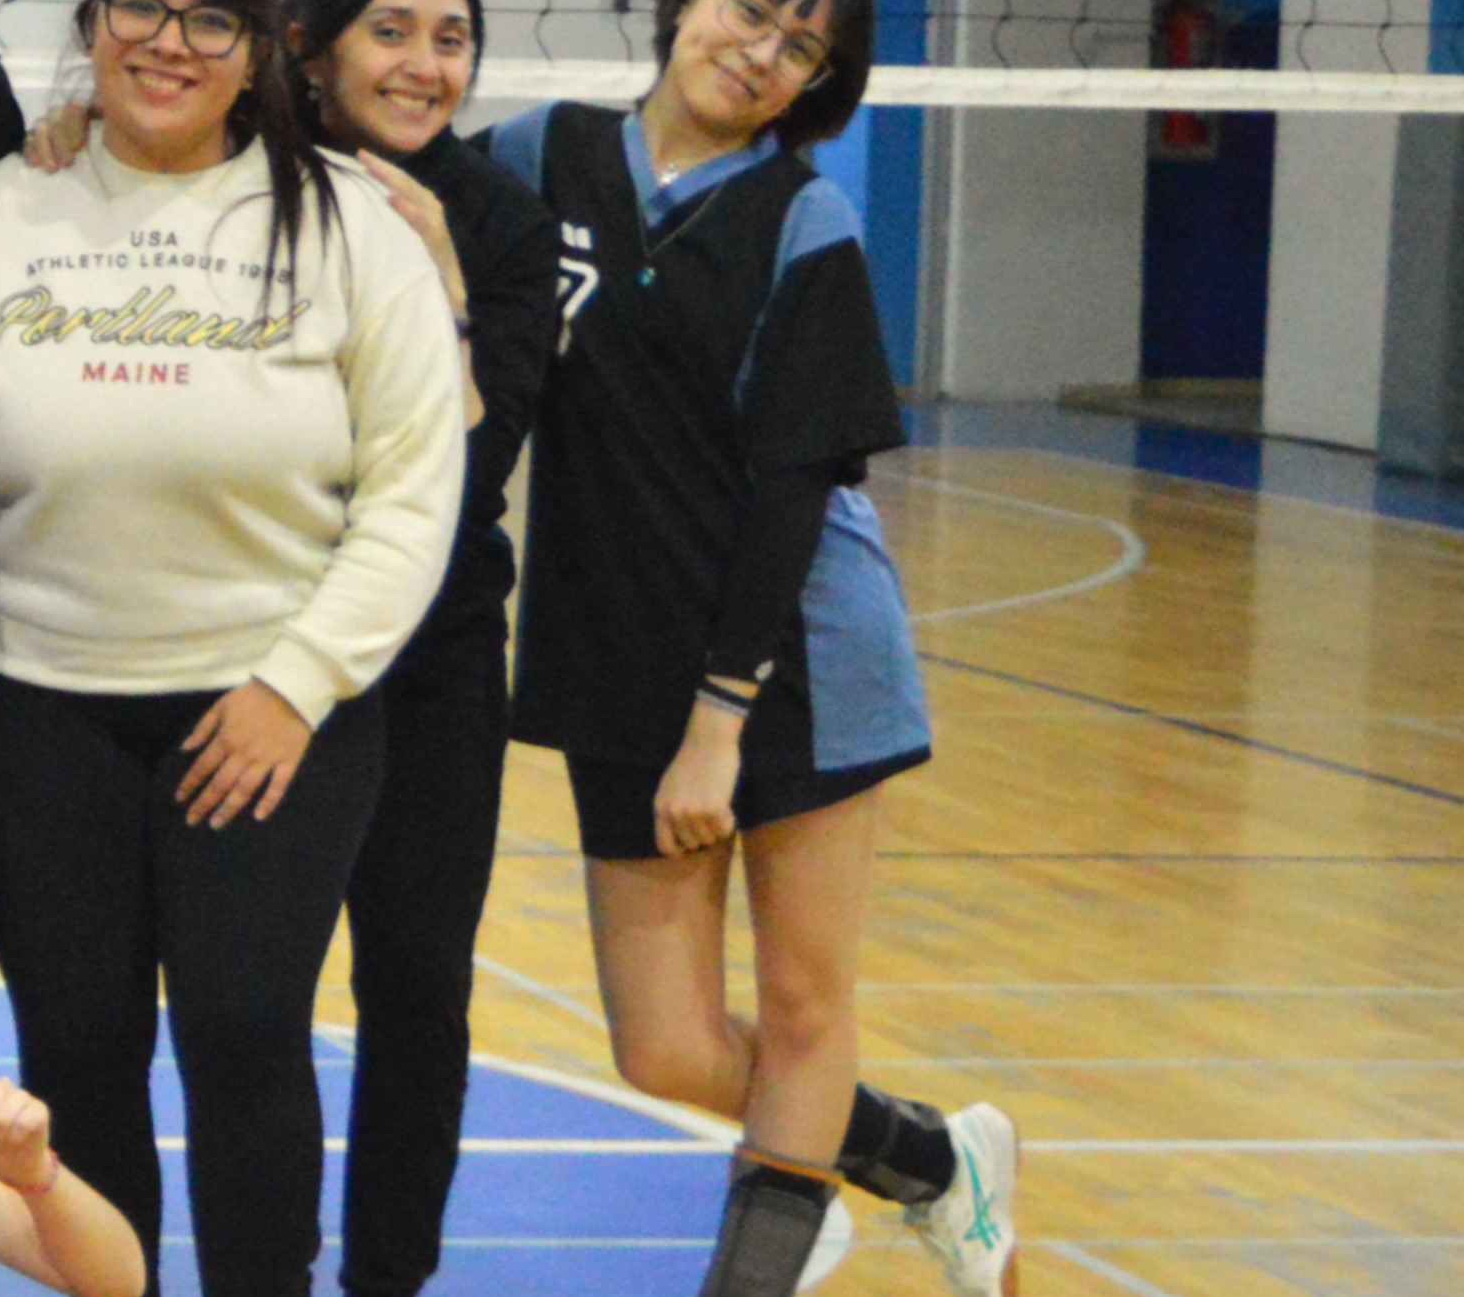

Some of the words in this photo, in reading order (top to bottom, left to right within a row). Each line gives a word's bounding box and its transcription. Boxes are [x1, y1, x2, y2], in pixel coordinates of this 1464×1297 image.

[130, 230, 178, 247] USA
[26, 253, 129, 277] ATHLETIC
[140, 252, 228, 273] LEAGUE
[82, 361, 191, 385] MAINE
